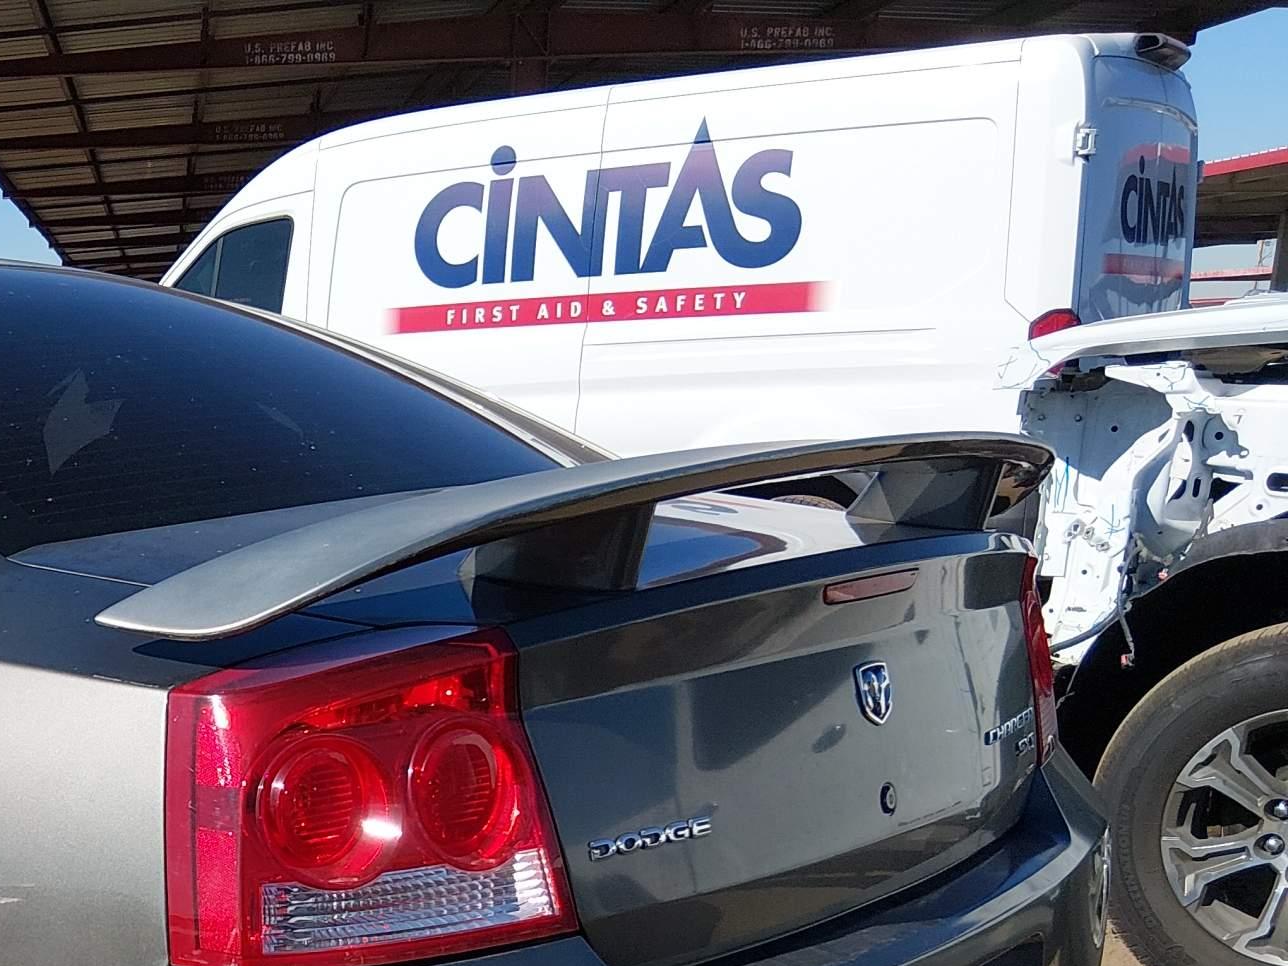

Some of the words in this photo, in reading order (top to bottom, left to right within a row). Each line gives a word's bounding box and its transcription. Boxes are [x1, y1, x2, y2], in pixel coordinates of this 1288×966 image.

[766, 26, 809, 38] PREFAB
[269, 41, 311, 53] PREFAB
[445, 304, 520, 326] FIRST
[536, 302, 582, 321] AID
[601, 300, 616, 316] &
[635, 291, 748, 315] SAFETY
[588, 816, 712, 861] DODGE
